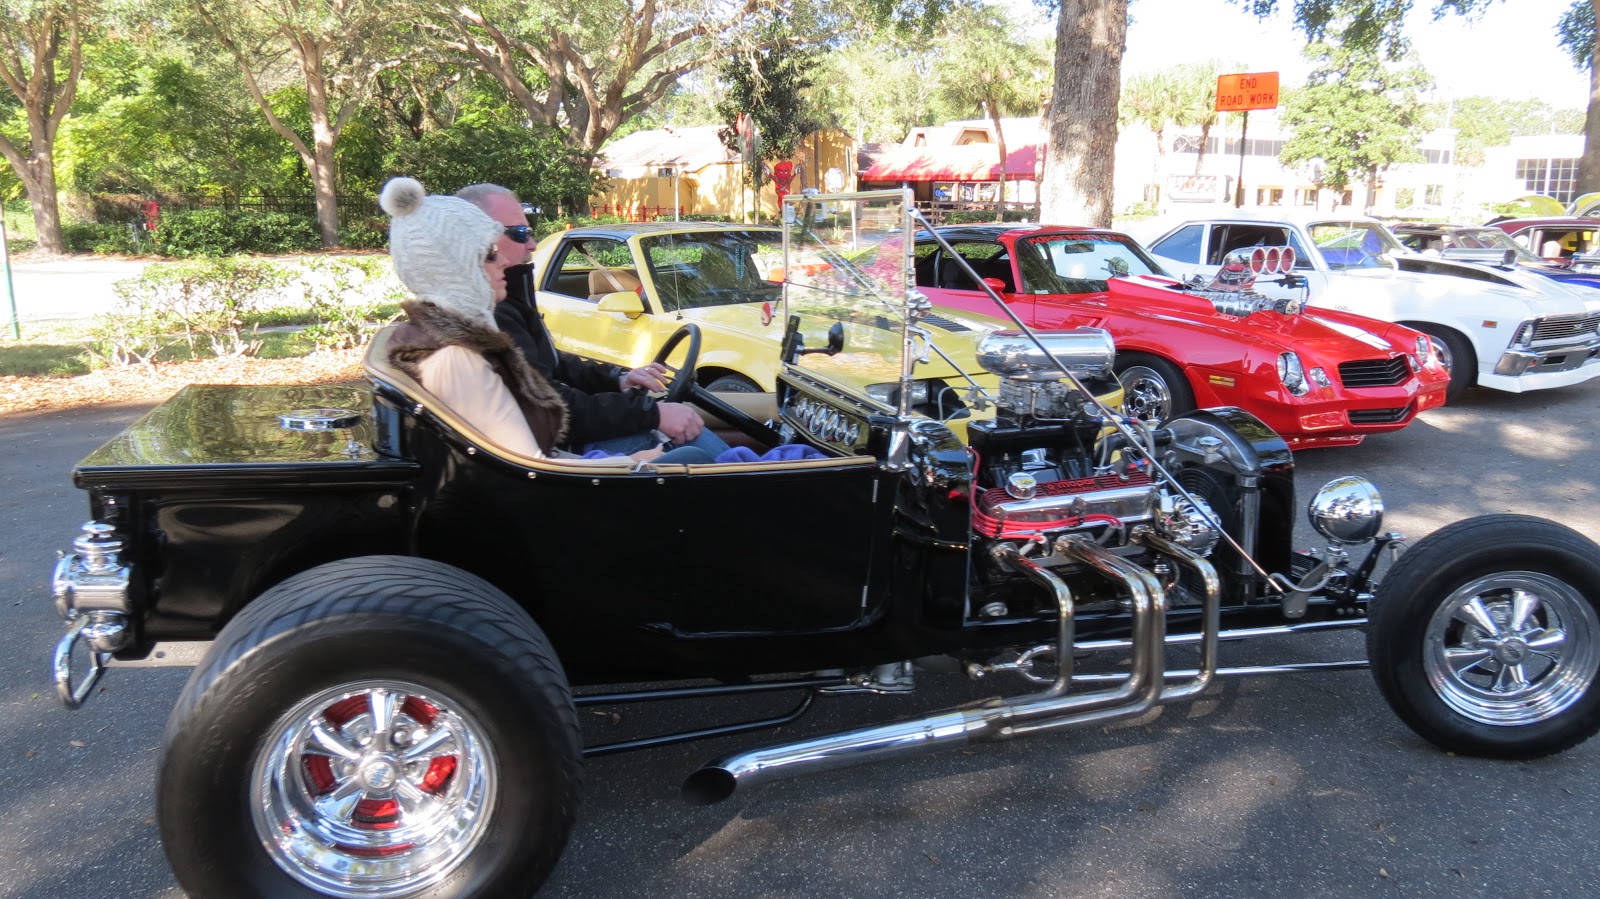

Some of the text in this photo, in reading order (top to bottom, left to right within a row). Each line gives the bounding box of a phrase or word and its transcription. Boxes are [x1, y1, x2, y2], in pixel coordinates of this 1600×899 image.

[1240, 78, 1257, 89] END
[1220, 93, 1274, 106] ROAD WORK
